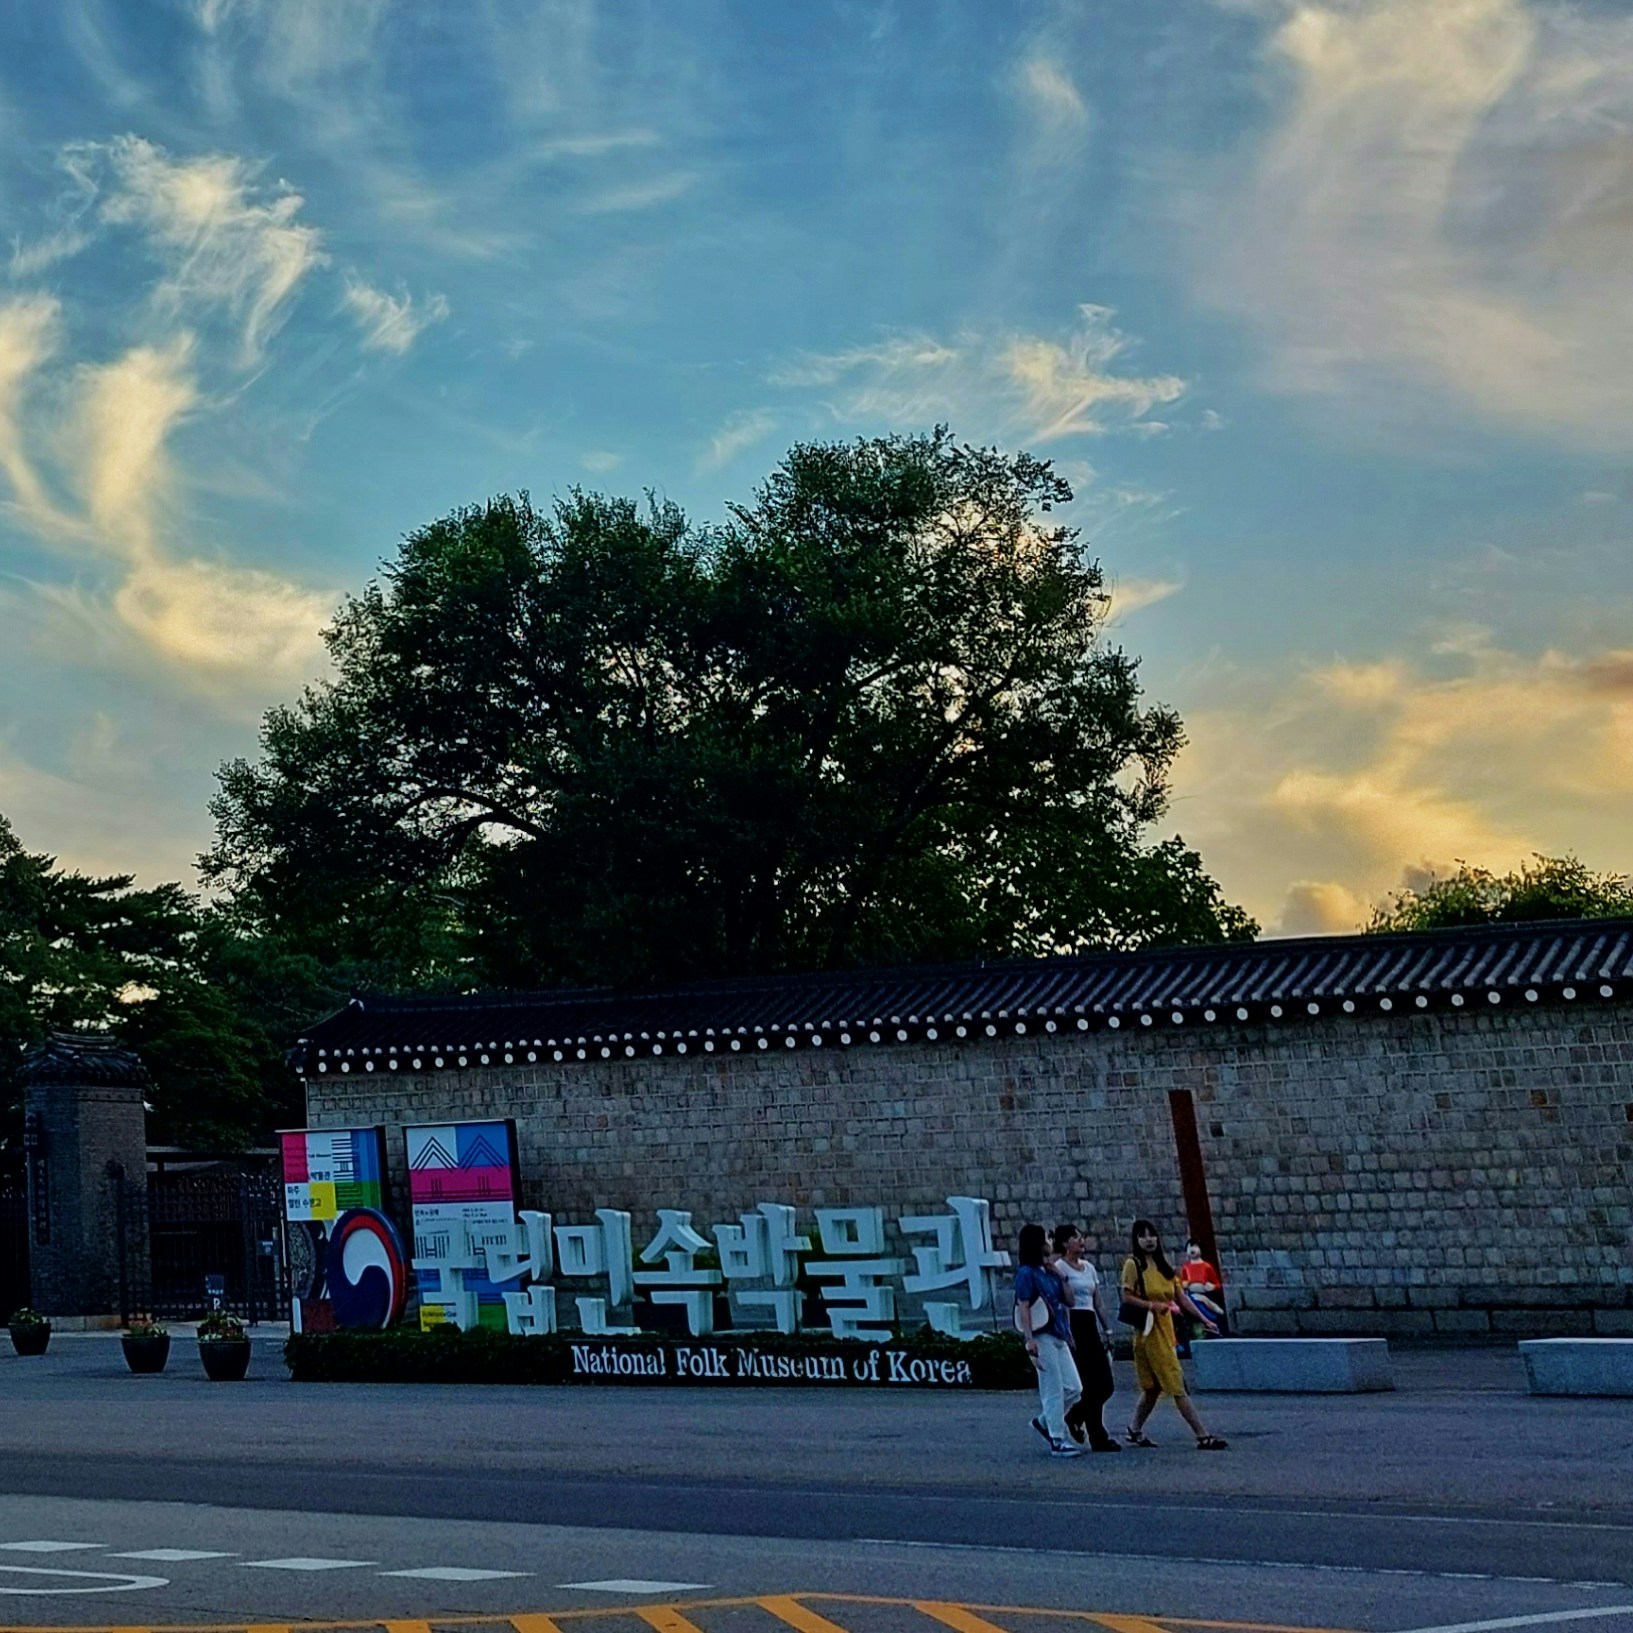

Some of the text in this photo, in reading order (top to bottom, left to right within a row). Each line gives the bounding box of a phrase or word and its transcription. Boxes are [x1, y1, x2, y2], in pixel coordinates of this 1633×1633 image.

[412, 1197, 1011, 1341] 국립민속박물관
[571, 1346, 973, 1384] National Folk Museum of Korea
